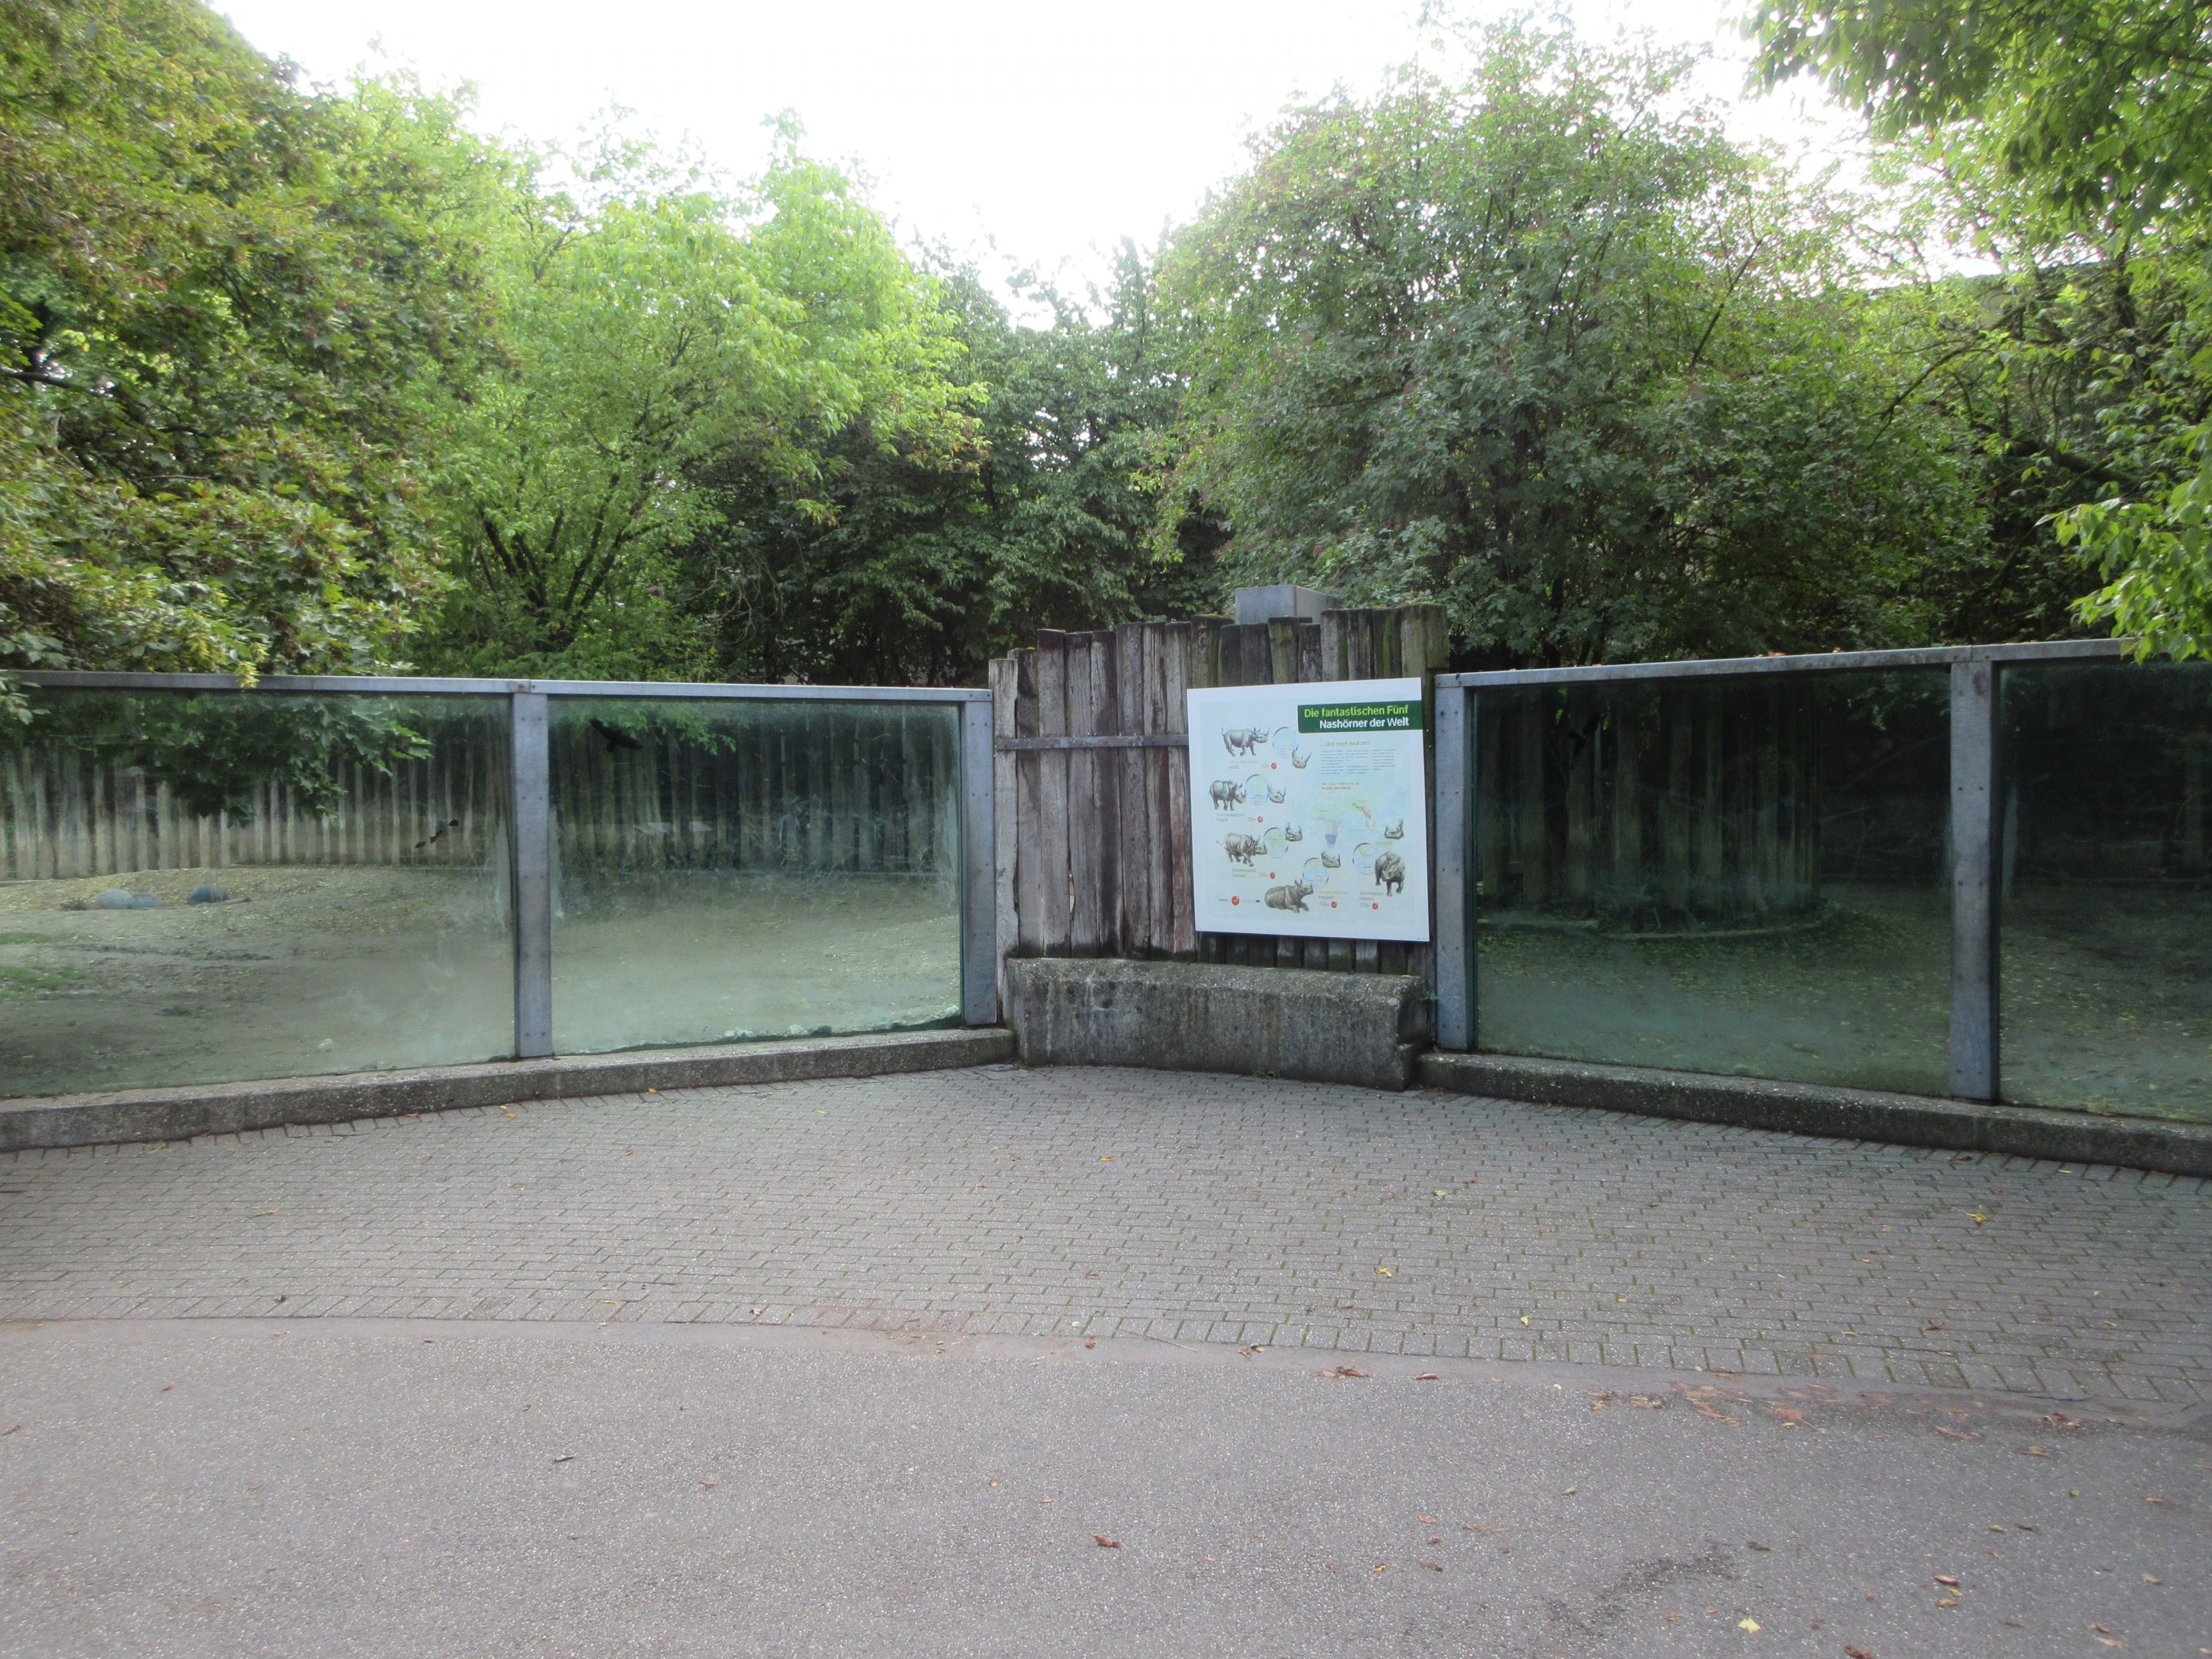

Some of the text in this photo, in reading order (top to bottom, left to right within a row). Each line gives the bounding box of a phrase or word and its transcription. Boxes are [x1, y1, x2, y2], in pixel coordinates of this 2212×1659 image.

[1304, 704, 1409, 717] Die fantastischen Fünf
[1320, 717, 1409, 729] Nashörner der Welt
